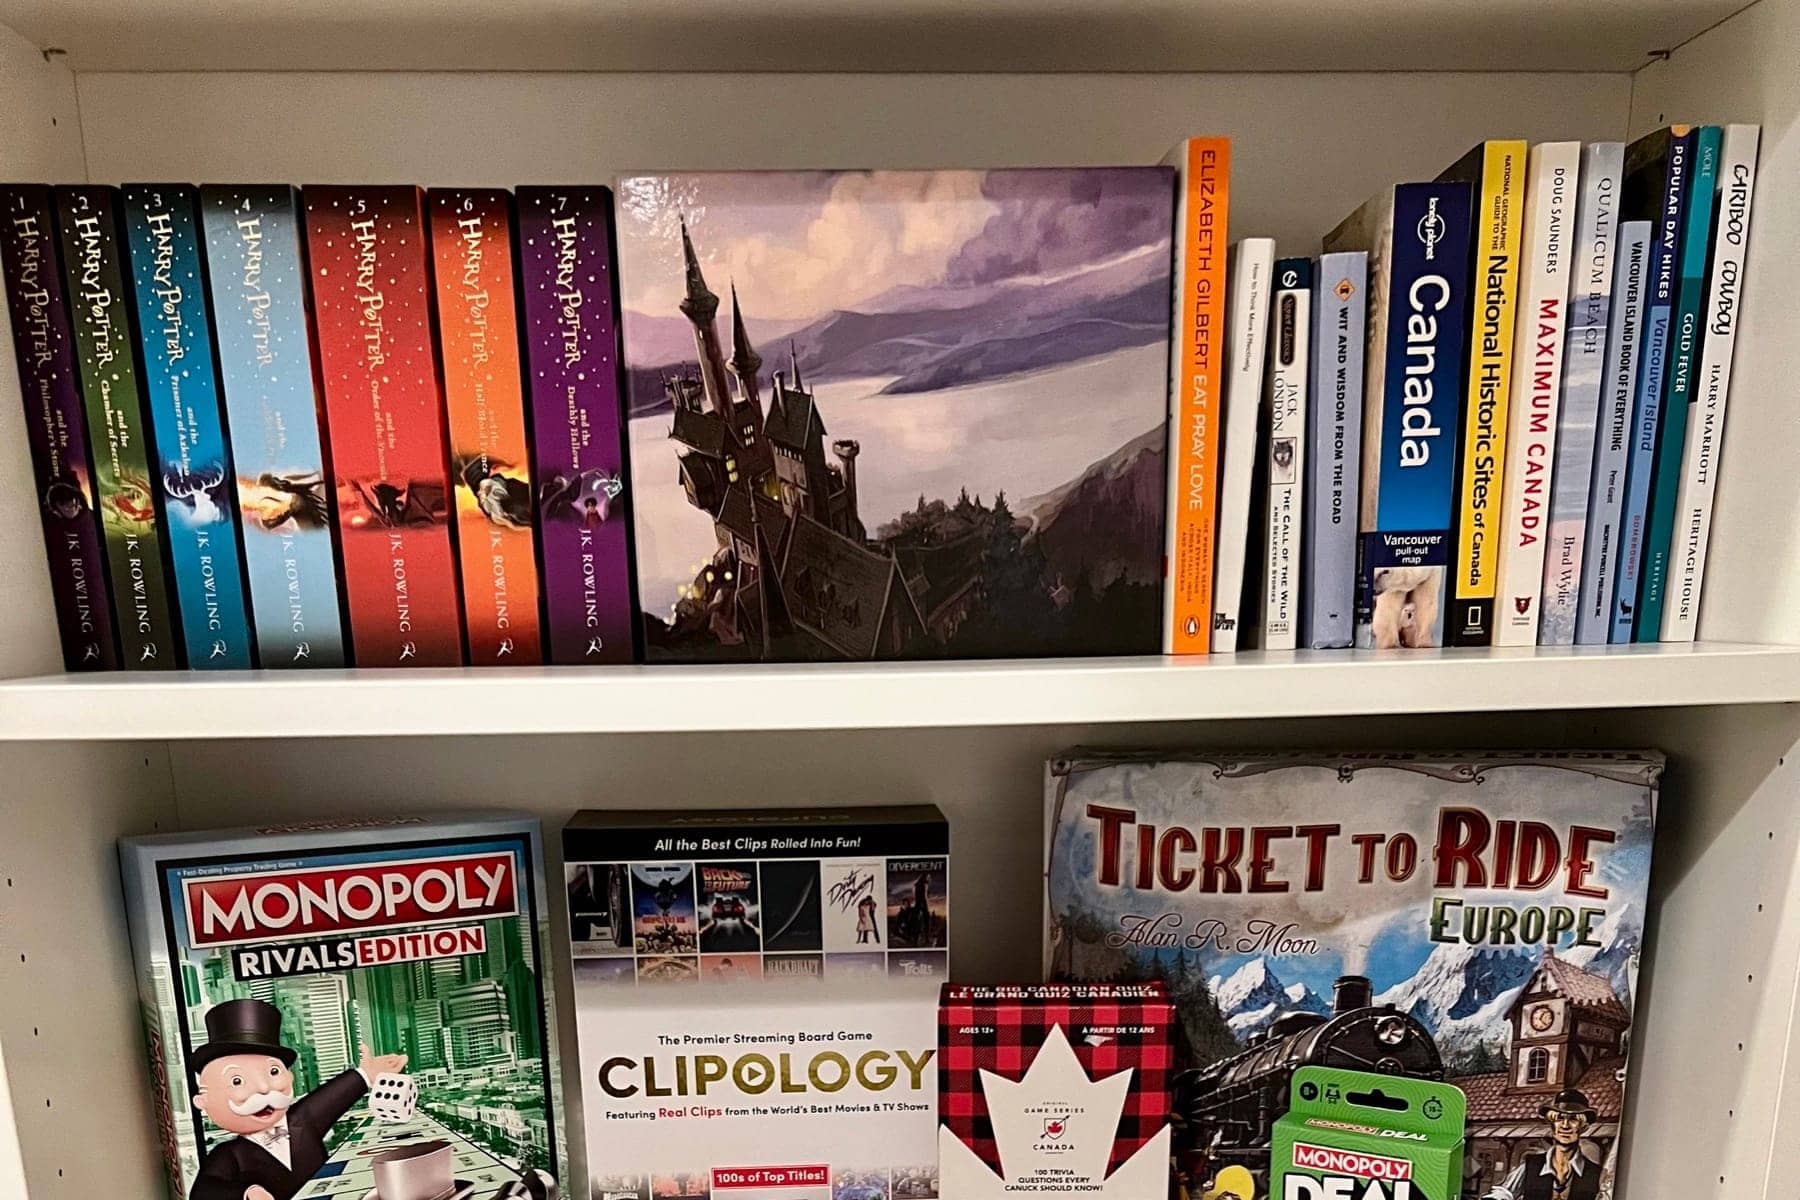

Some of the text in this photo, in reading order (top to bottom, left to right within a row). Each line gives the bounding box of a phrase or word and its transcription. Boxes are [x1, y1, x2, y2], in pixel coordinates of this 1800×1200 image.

[1198, 150, 1216, 271] ELIZABETH
[1546, 168, 1565, 274] DOUG SAUNDERS
[1658, 145, 1684, 299] POPULAR DAY HIKES
[74, 216, 114, 369] HARRY POTTER
[147, 213, 184, 366] HARRY POTTER
[350, 220, 384, 371] HARRY POTTER
[458, 218, 489, 368] HARRY POTTER
[552, 218, 582, 369] HARRY POTTER
[1584, 176, 1613, 354] QUALICUM BEACH
[1710, 260, 1738, 336] COWBOY
[1194, 279, 1211, 370] GILBERT
[1611, 241, 1643, 450] VANCOUVER ISLAND BOOK OF EVERYTHING
[1674, 313, 1694, 393] GOLD FEVER
[1191, 374, 1207, 408] EAT
[1400, 274, 1450, 468] Canada
[1191, 415, 1205, 461] PRAY
[1332, 306, 1349, 525] WIT AND WISDOM FROM THE ROAD
[1470, 256, 1508, 586] National Historic Sites of Canada
[1519, 298, 1560, 547] MAXIMUM CANADA
[1697, 363, 1721, 485] HARRY MARRIOTT
[1188, 464, 1204, 511] LOVE
[1283, 488, 1291, 511] THE
[1282, 515, 1291, 545] CALL
[1282, 549, 1289, 562] OF
[1384, 534, 1442, 545] Vancouver
[1395, 545, 1429, 557] pull-out
[1402, 555, 1422, 565] map
[1680, 508, 1701, 620] HERITAGE HOUSE
[655, 837, 861, 851] All the Best Clips Rolled Into Fun!
[1086, 803, 1617, 900] TICKET TO RIDE
[202, 864, 506, 935] MONOPOLY
[1106, 914, 1183, 950] Alan
[1234, 922, 1321, 956] Moon
[1430, 896, 1606, 948] EUROPE
[240, 928, 483, 977] RIVALS EDITION
[598, 1049, 937, 1098] CLIPOLOGY
[658, 1031, 872, 1046] The Premier Streaming Board Game
[606, 1102, 929, 1120] Featuring Real Clips from the World's Best Movies & TV Shows
[717, 1170, 825, 1184] 100s of Top Titles!
[1297, 1148, 1409, 1179] MONOPOLY
